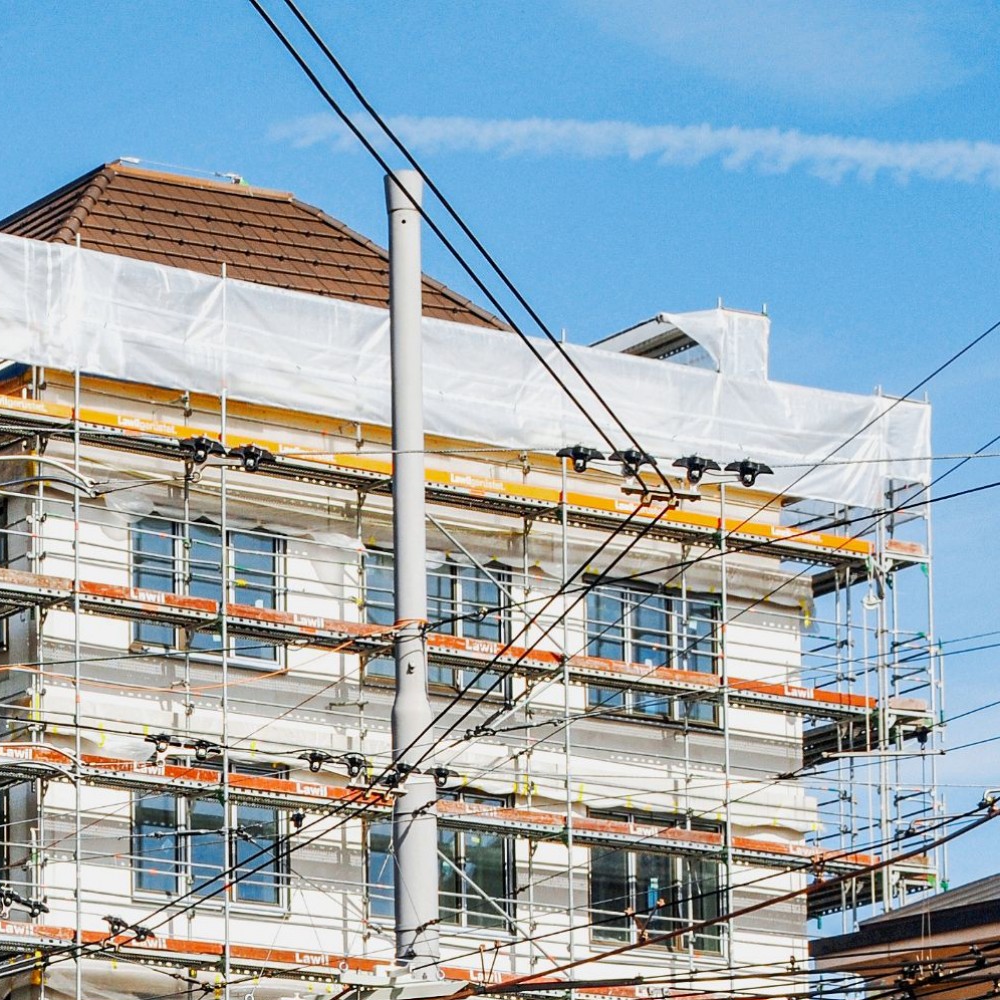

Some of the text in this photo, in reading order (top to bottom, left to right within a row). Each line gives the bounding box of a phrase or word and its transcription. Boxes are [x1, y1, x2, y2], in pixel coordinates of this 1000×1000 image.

[0, 746, 33, 760] Lawil
[296, 782, 328, 798] Lawil
[295, 952, 329, 966] Lawil
